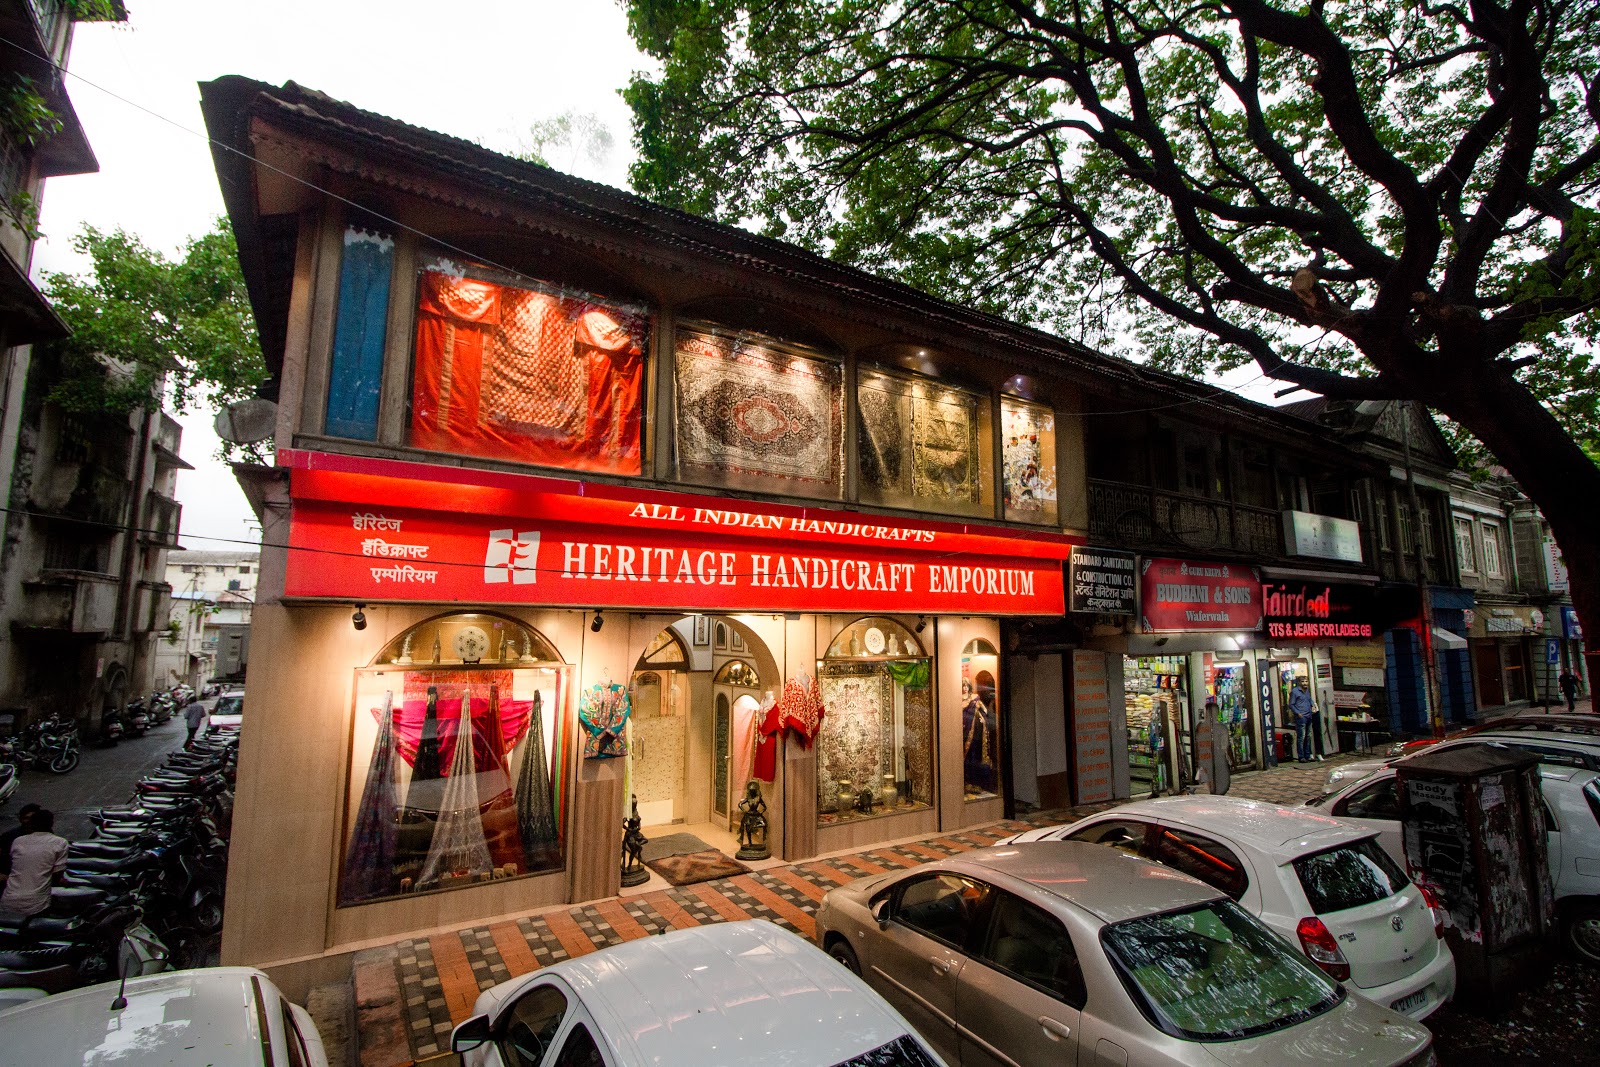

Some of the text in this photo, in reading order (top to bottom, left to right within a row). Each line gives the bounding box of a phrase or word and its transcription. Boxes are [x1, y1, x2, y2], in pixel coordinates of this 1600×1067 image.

[352, 512, 403, 532] हेरिटेज
[629, 502, 936, 543] ALL INDIAN HANDICRAFTS
[562, 541, 1035, 596] HERITAGE HANDICRAFT EMPORIUM
[1073, 553, 1134, 570] STANDARD SANITATION
[370, 564, 438, 583] एम्पोरियम
[1076, 570, 1134, 586] & CONSTRUCTION CO.
[1188, 567, 1203, 577] GURU
[1156, 583, 1251, 604] BUDHANI & SONS
[1185, 610, 1229, 622] Waferwala
[1285, 622, 1293, 637] &
[1293, 622, 1319, 637] JEANS
[1319, 623, 1335, 637] FOR
[1335, 623, 1360, 637] LADIES
[1260, 670, 1274, 757] JOCKEY
[1411, 790, 1453, 802] Massage
[1415, 783, 1447, 795] Body
